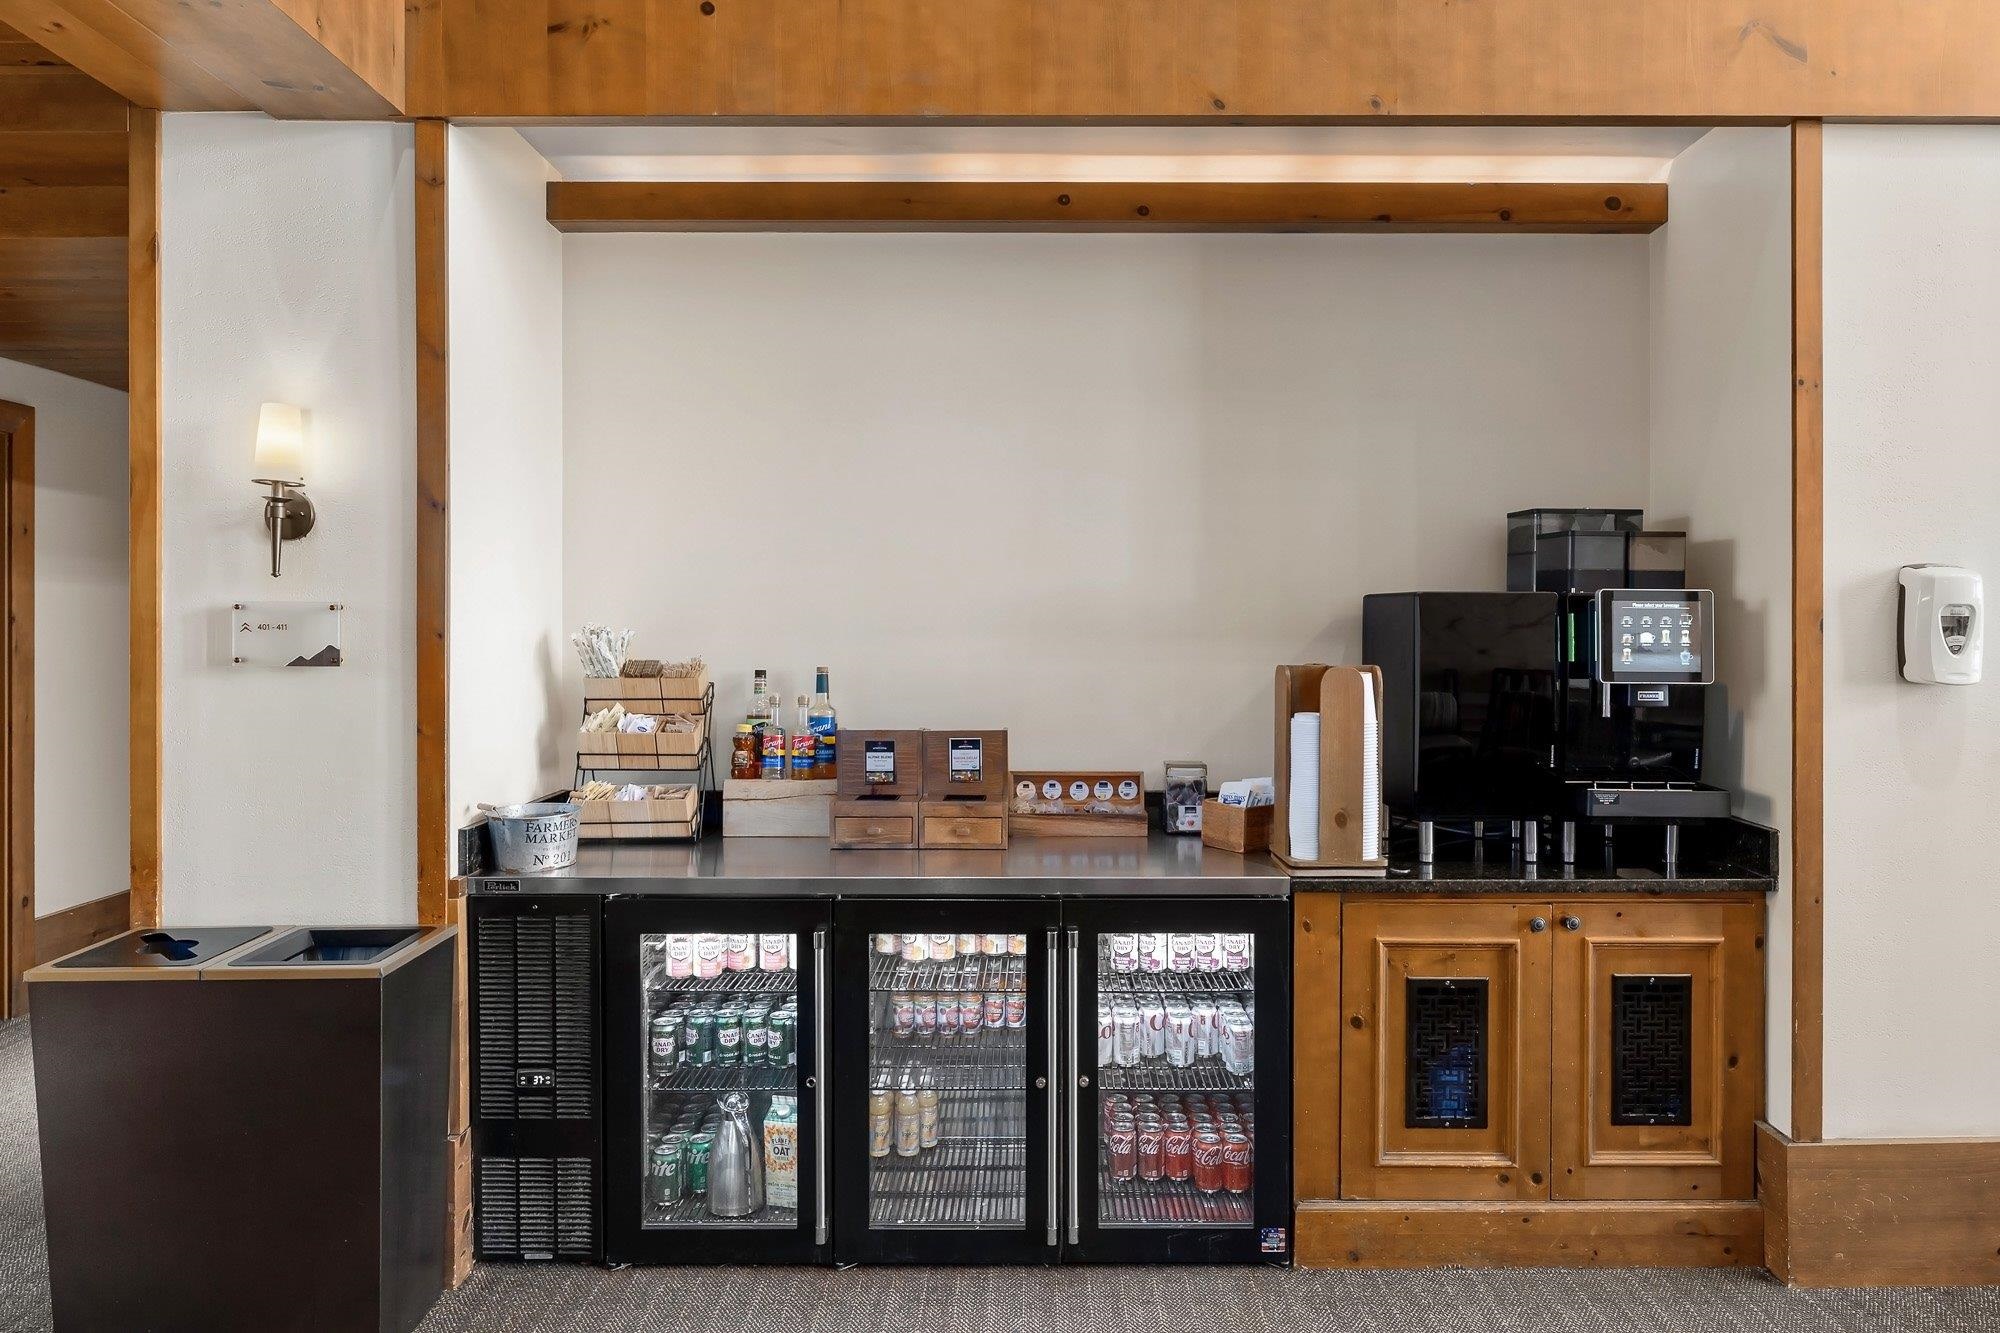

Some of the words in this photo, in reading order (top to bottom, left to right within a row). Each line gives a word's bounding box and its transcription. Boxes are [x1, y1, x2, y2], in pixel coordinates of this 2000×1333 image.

[257, 623, 270, 631] 401
[276, 623, 288, 631] 411
[533, 1075, 544, 1085] 37
[773, 1147, 790, 1156] OAT
[1109, 1134, 1132, 1155] Cola
[1138, 1134, 1161, 1155] Cola
[1165, 1134, 1190, 1155] Cola
